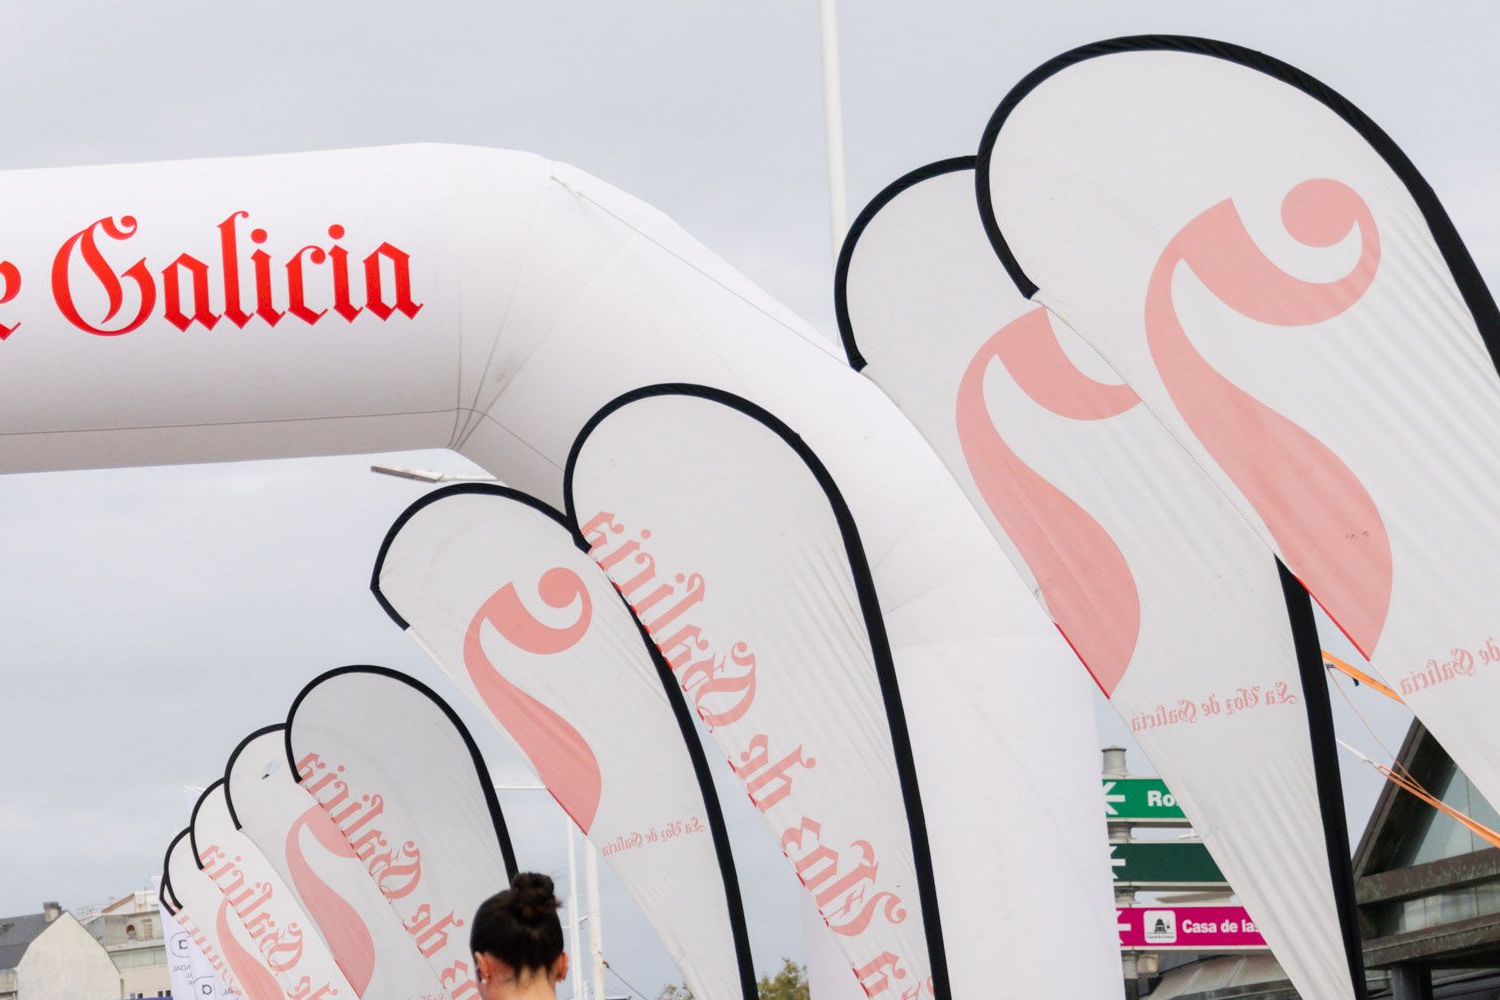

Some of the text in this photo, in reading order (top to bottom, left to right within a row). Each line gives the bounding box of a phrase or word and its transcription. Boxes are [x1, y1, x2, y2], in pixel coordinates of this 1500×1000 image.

[50, 210, 424, 338] Galicia
[1147, 790, 1180, 807] Ro
[1182, 919, 1259, 933] Casa de la
